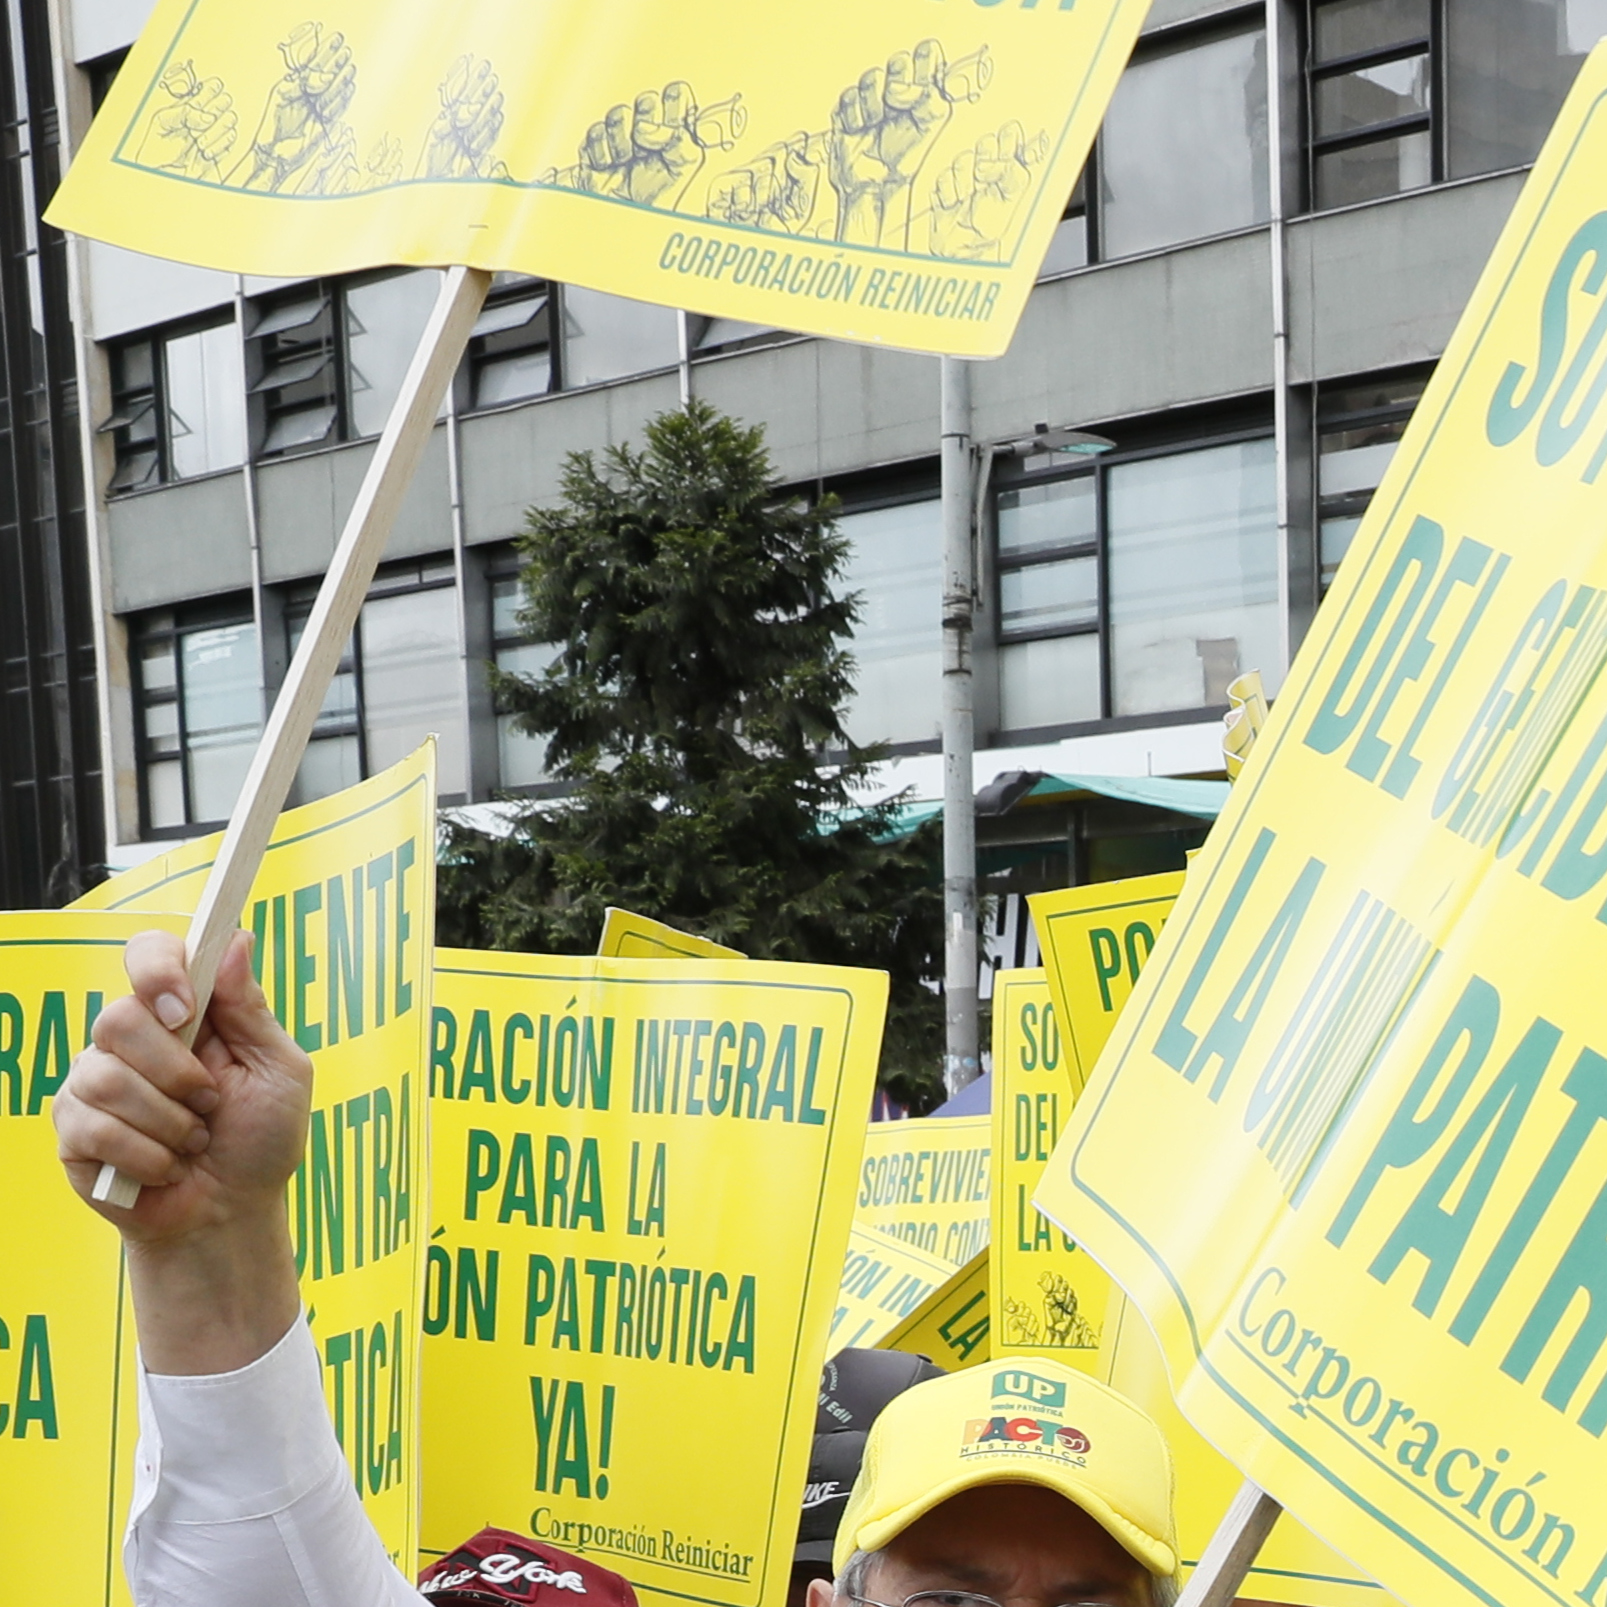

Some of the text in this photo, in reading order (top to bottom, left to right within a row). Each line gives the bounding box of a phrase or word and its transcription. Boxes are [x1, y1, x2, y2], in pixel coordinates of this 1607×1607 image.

[658, 231, 1000, 322] CORPORACIÓN REINICIAR
[1302, 513, 1513, 801] DEL
[1151, 826, 1326, 1104] LA
[632, 1018, 826, 1126] INTEGRAL
[463, 1128, 667, 1238] PARA LA
[859, 1148, 991, 1209] SOBREVIVIE
[523, 1246, 756, 1374] PATRIÓTICA
[306, 1303, 403, 1501] TICA
[961, 1416, 1092, 1454] PACTO
[1004, 1373, 1056, 1400] UP
[1016, 1404, 1064, 1418] PATRIÓTICA
[1237, 1267, 1576, 1580] Corporación
[529, 1375, 616, 1501] YA!
[960, 1441, 1087, 1465] HISTÓRICO
[479, 1553, 588, 1594] York
[530, 1507, 754, 1577] Corporación Reiniciar
